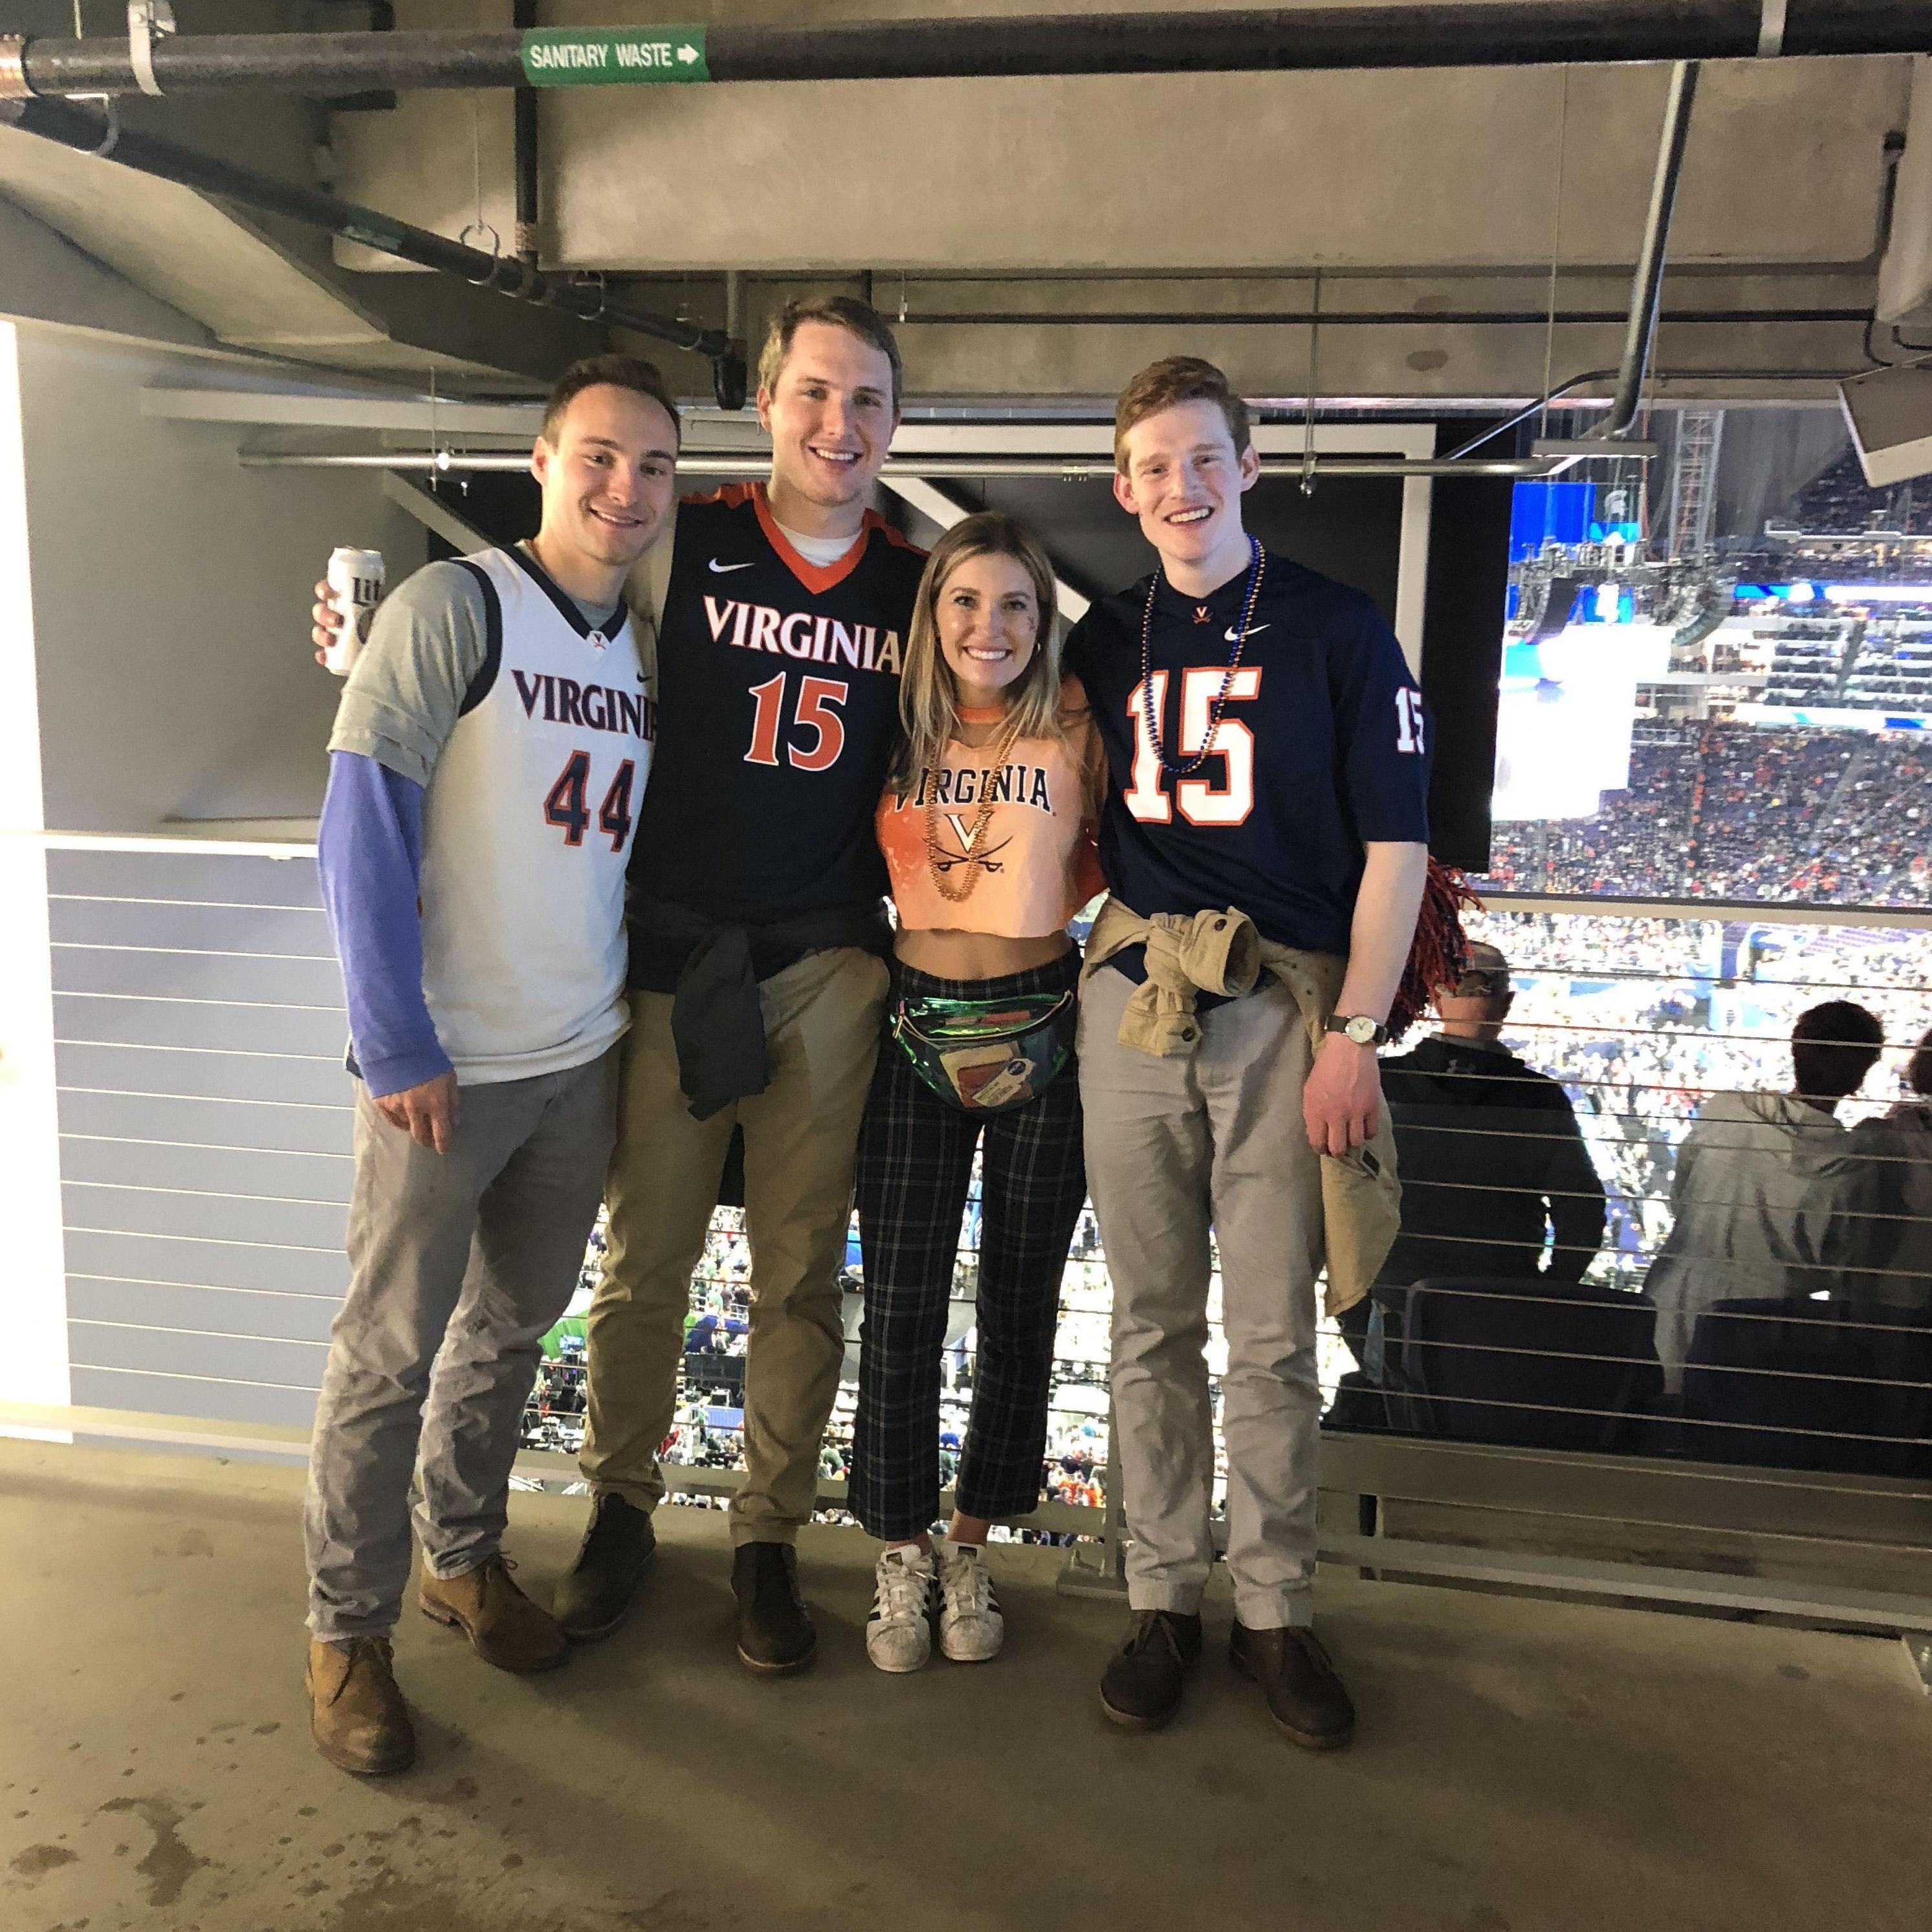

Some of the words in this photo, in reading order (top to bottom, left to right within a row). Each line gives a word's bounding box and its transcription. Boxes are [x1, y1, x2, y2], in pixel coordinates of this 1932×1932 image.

[530, 43, 609, 68] SANITARY
[615, 42, 672, 67] WASTE
[703, 595, 902, 677] VIRGINIA
[511, 669, 655, 742] VIRGINI
[743, 671, 849, 772] 15
[1124, 666, 1262, 827] 15
[543, 749, 635, 853] 44
[944, 813, 995, 853] V
